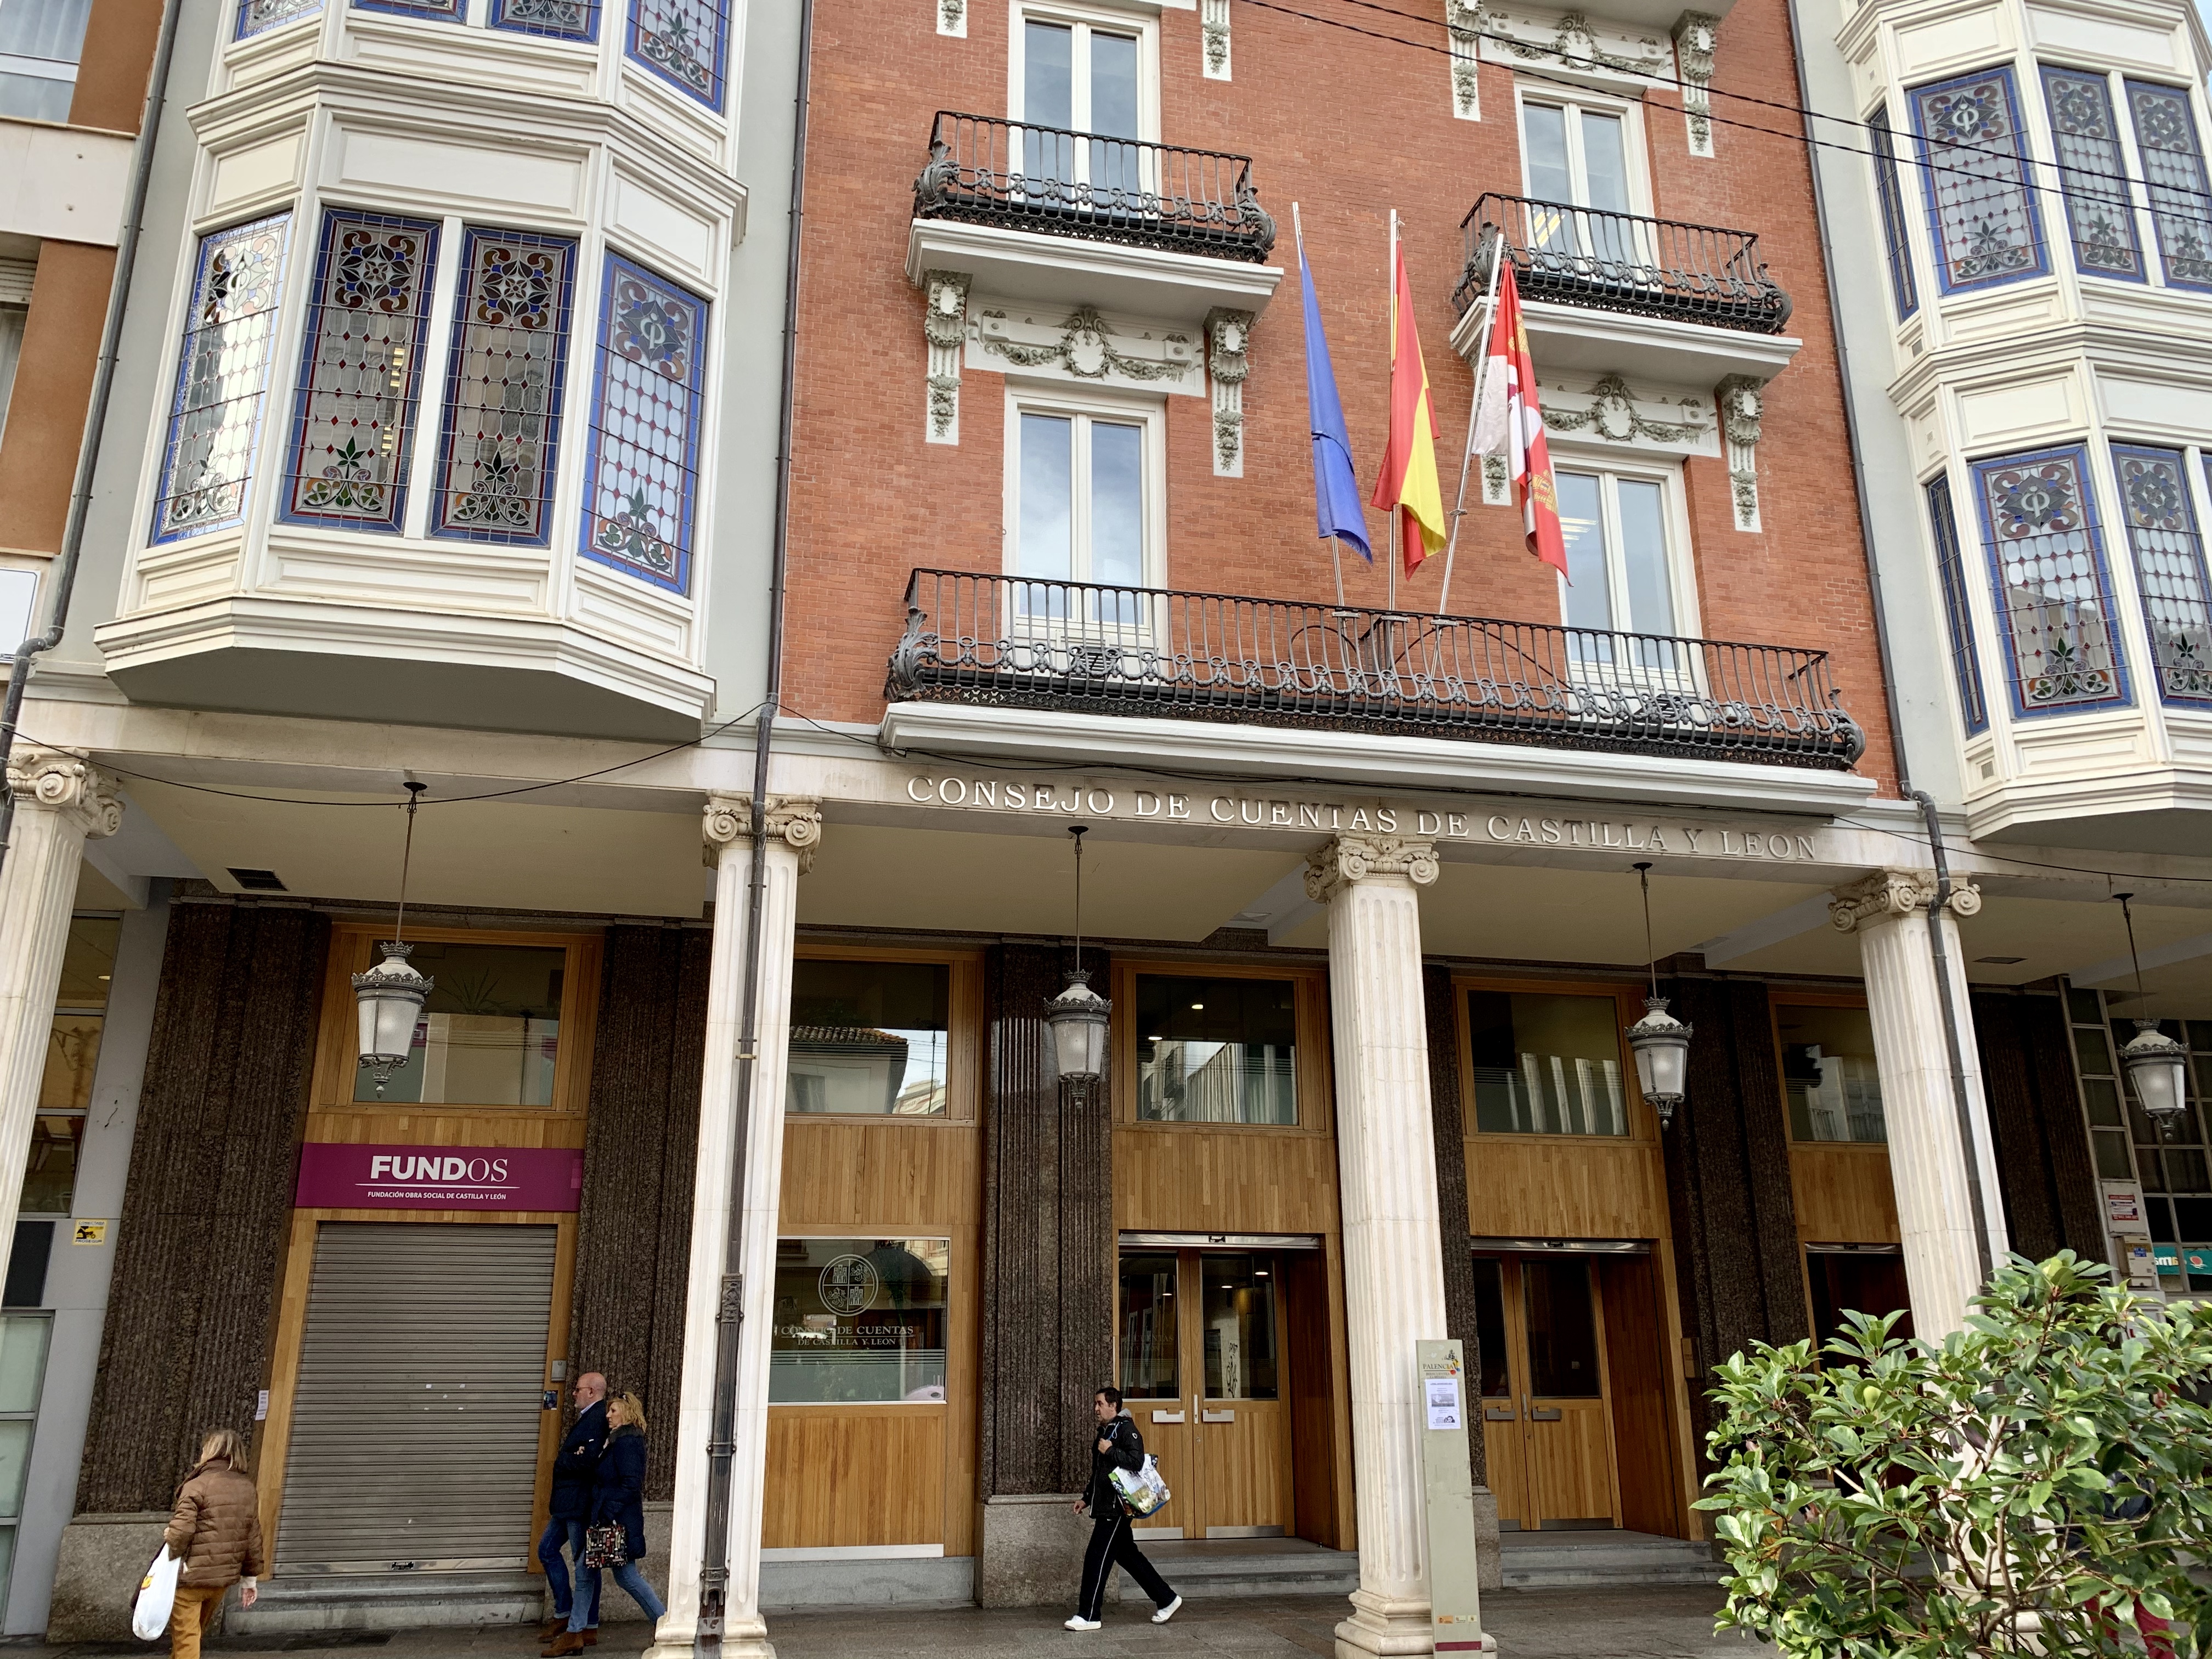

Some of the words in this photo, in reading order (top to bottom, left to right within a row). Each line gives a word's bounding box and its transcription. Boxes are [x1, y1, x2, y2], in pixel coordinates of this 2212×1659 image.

[907, 775, 1114, 815] CONSEJO
[1135, 790, 1191, 819] DE
[1210, 796, 1397, 833] CUENTAS
[1417, 810, 1470, 837] DE
[1487, 815, 1668, 851] CASTILLA
[1683, 827, 1703, 853] Y
[1720, 831, 1816, 860] LEON
[370, 1155, 508, 1182] FUNDOS
[856, 1326, 913, 1334] CUENTAS
